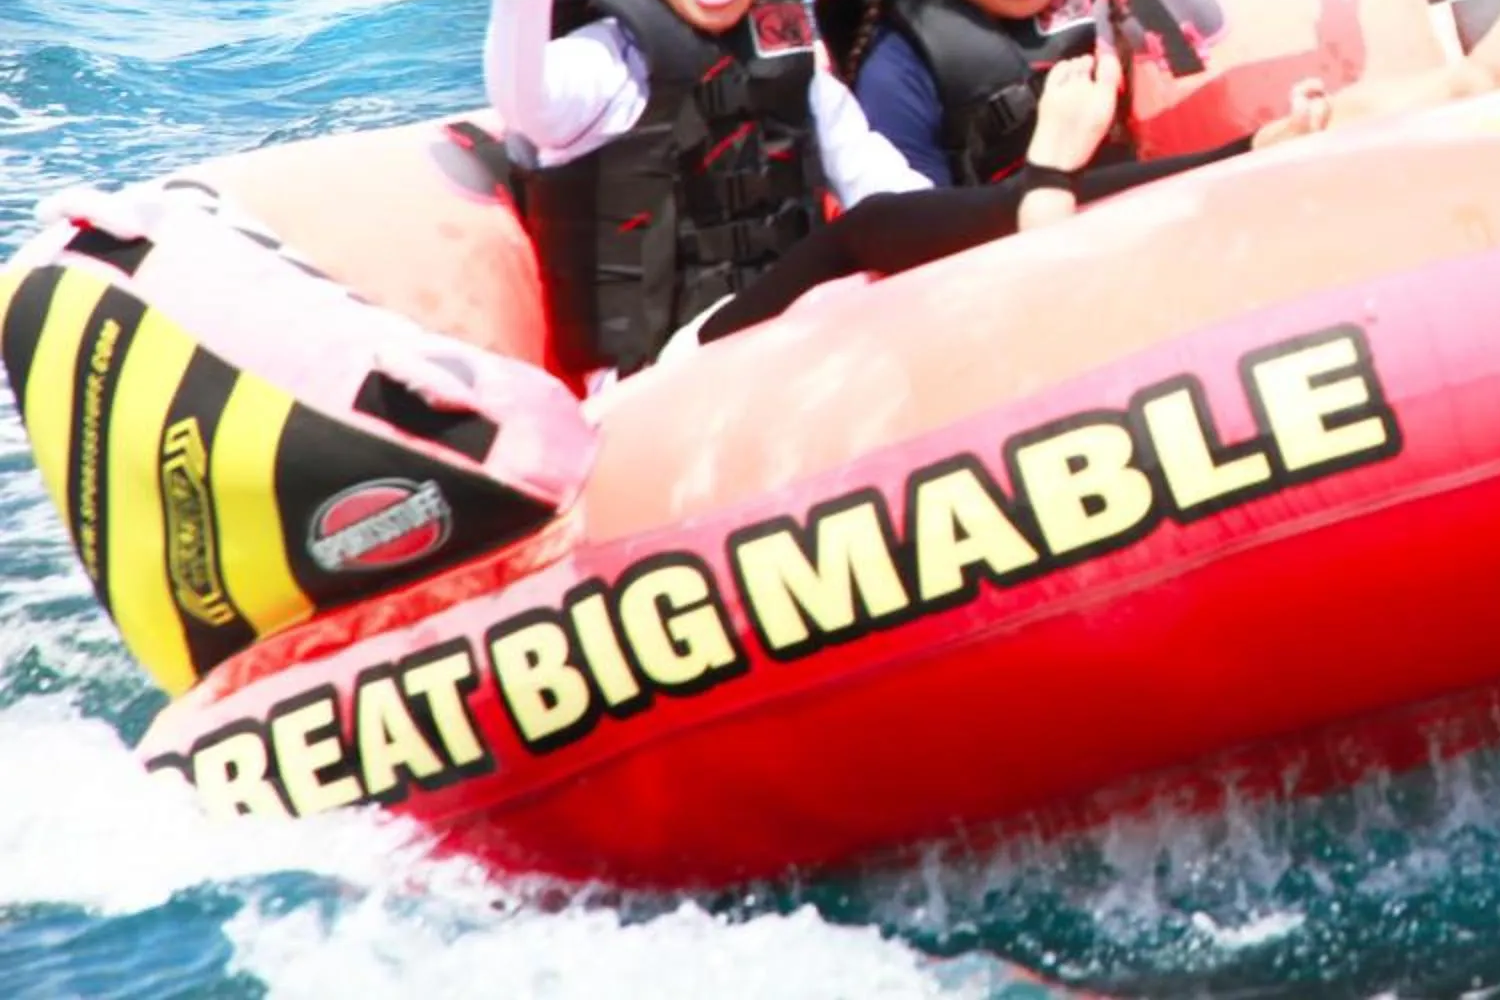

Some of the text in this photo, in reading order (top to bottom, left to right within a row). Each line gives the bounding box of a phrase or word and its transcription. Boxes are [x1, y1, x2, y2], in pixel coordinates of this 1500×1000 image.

[146, 334, 1389, 820] REAT BIG MABLE
